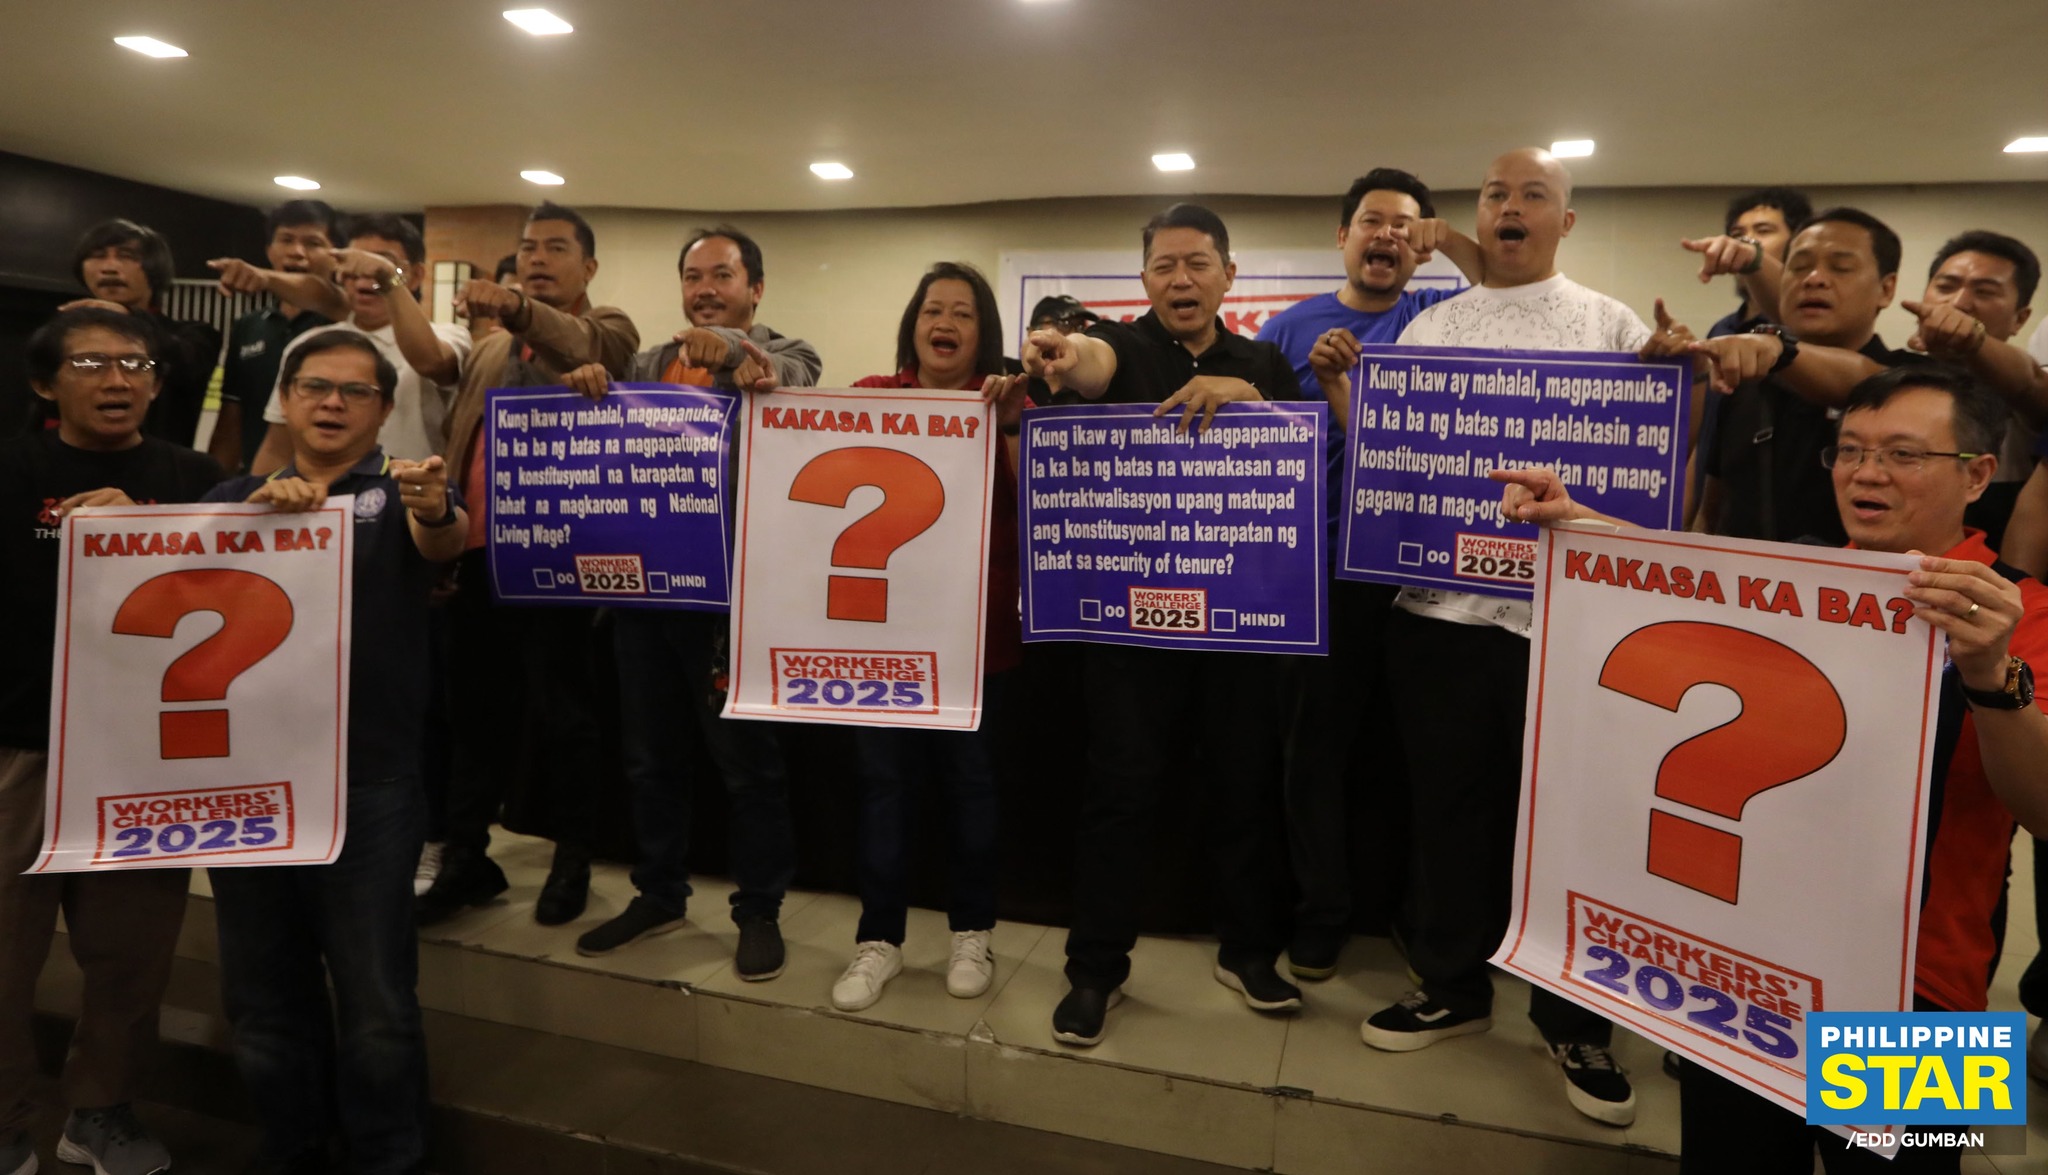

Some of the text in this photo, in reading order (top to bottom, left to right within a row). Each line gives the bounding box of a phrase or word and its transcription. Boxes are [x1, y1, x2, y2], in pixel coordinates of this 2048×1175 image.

[1369, 363, 1673, 407] Kung ikaw ay mahalal, magpapanuka-
[498, 405, 724, 432] Kung ikaw ay mahalal, magpapanuka-
[762, 407, 980, 438] KAKASA KA BA?
[1363, 403, 1669, 455] la ka ba ng batas na palalakasin ang
[497, 432, 718, 460] la ka ba ng batas na magpapatupad
[1033, 427, 1068, 451] Kung
[1073, 425, 1105, 445] ikaw
[1111, 427, 1127, 449] ay
[496, 464, 717, 490] ng konstitusyonal na karapatan ng
[1032, 456, 1305, 482] la ka ba ng batas na wawakasan ang
[1359, 443, 1470, 480] konstitusyonal
[1474, 456, 1492, 478] na
[1587, 467, 1606, 494] ng
[1612, 467, 1667, 498] mang-
[496, 494, 718, 519] lahat na magkaroon ng National
[1033, 487, 1295, 514] kontraktwalisasyon upang matupad
[1356, 487, 1414, 516] gagawa
[1419, 493, 1437, 515] na
[84, 527, 332, 557] KAKASA KA BA?
[495, 524, 571, 548] Living Wage?
[1033, 519, 1297, 548] ang konstitusyonal na karapatan ng
[1462, 538, 1537, 552] WORKERS'
[579, 559, 637, 567] WORKERS'
[1034, 550, 1234, 577] lahat sa security of tenure?
[1427, 550, 1449, 565] OO
[1461, 546, 1537, 560] CHALLENGE
[557, 573, 575, 584] OO
[580, 565, 639, 574] CHALLENGE
[1461, 555, 1535, 579] 2025
[584, 574, 640, 589] 2025
[671, 576, 706, 588] HINDI
[1565, 549, 1915, 634] KAKASA KA BA?
[1134, 591, 1201, 602] WORKERS'
[1134, 600, 1201, 610] CHALLENGE
[1105, 606, 1125, 618] OO
[1135, 608, 1200, 628] 2025
[1240, 613, 1285, 627] HINDI
[782, 655, 924, 671] WORKERS'
[783, 667, 926, 681] CHALLENGE
[786, 679, 925, 708] 2025
[112, 789, 278, 817] WORKERS'
[113, 803, 280, 829] CHALLENGE
[112, 816, 278, 858] 2025
[1583, 905, 1798, 998] WORKERS'
[1582, 926, 1803, 1022] CHALLENGE
[1583, 945, 1799, 1059] 2025
